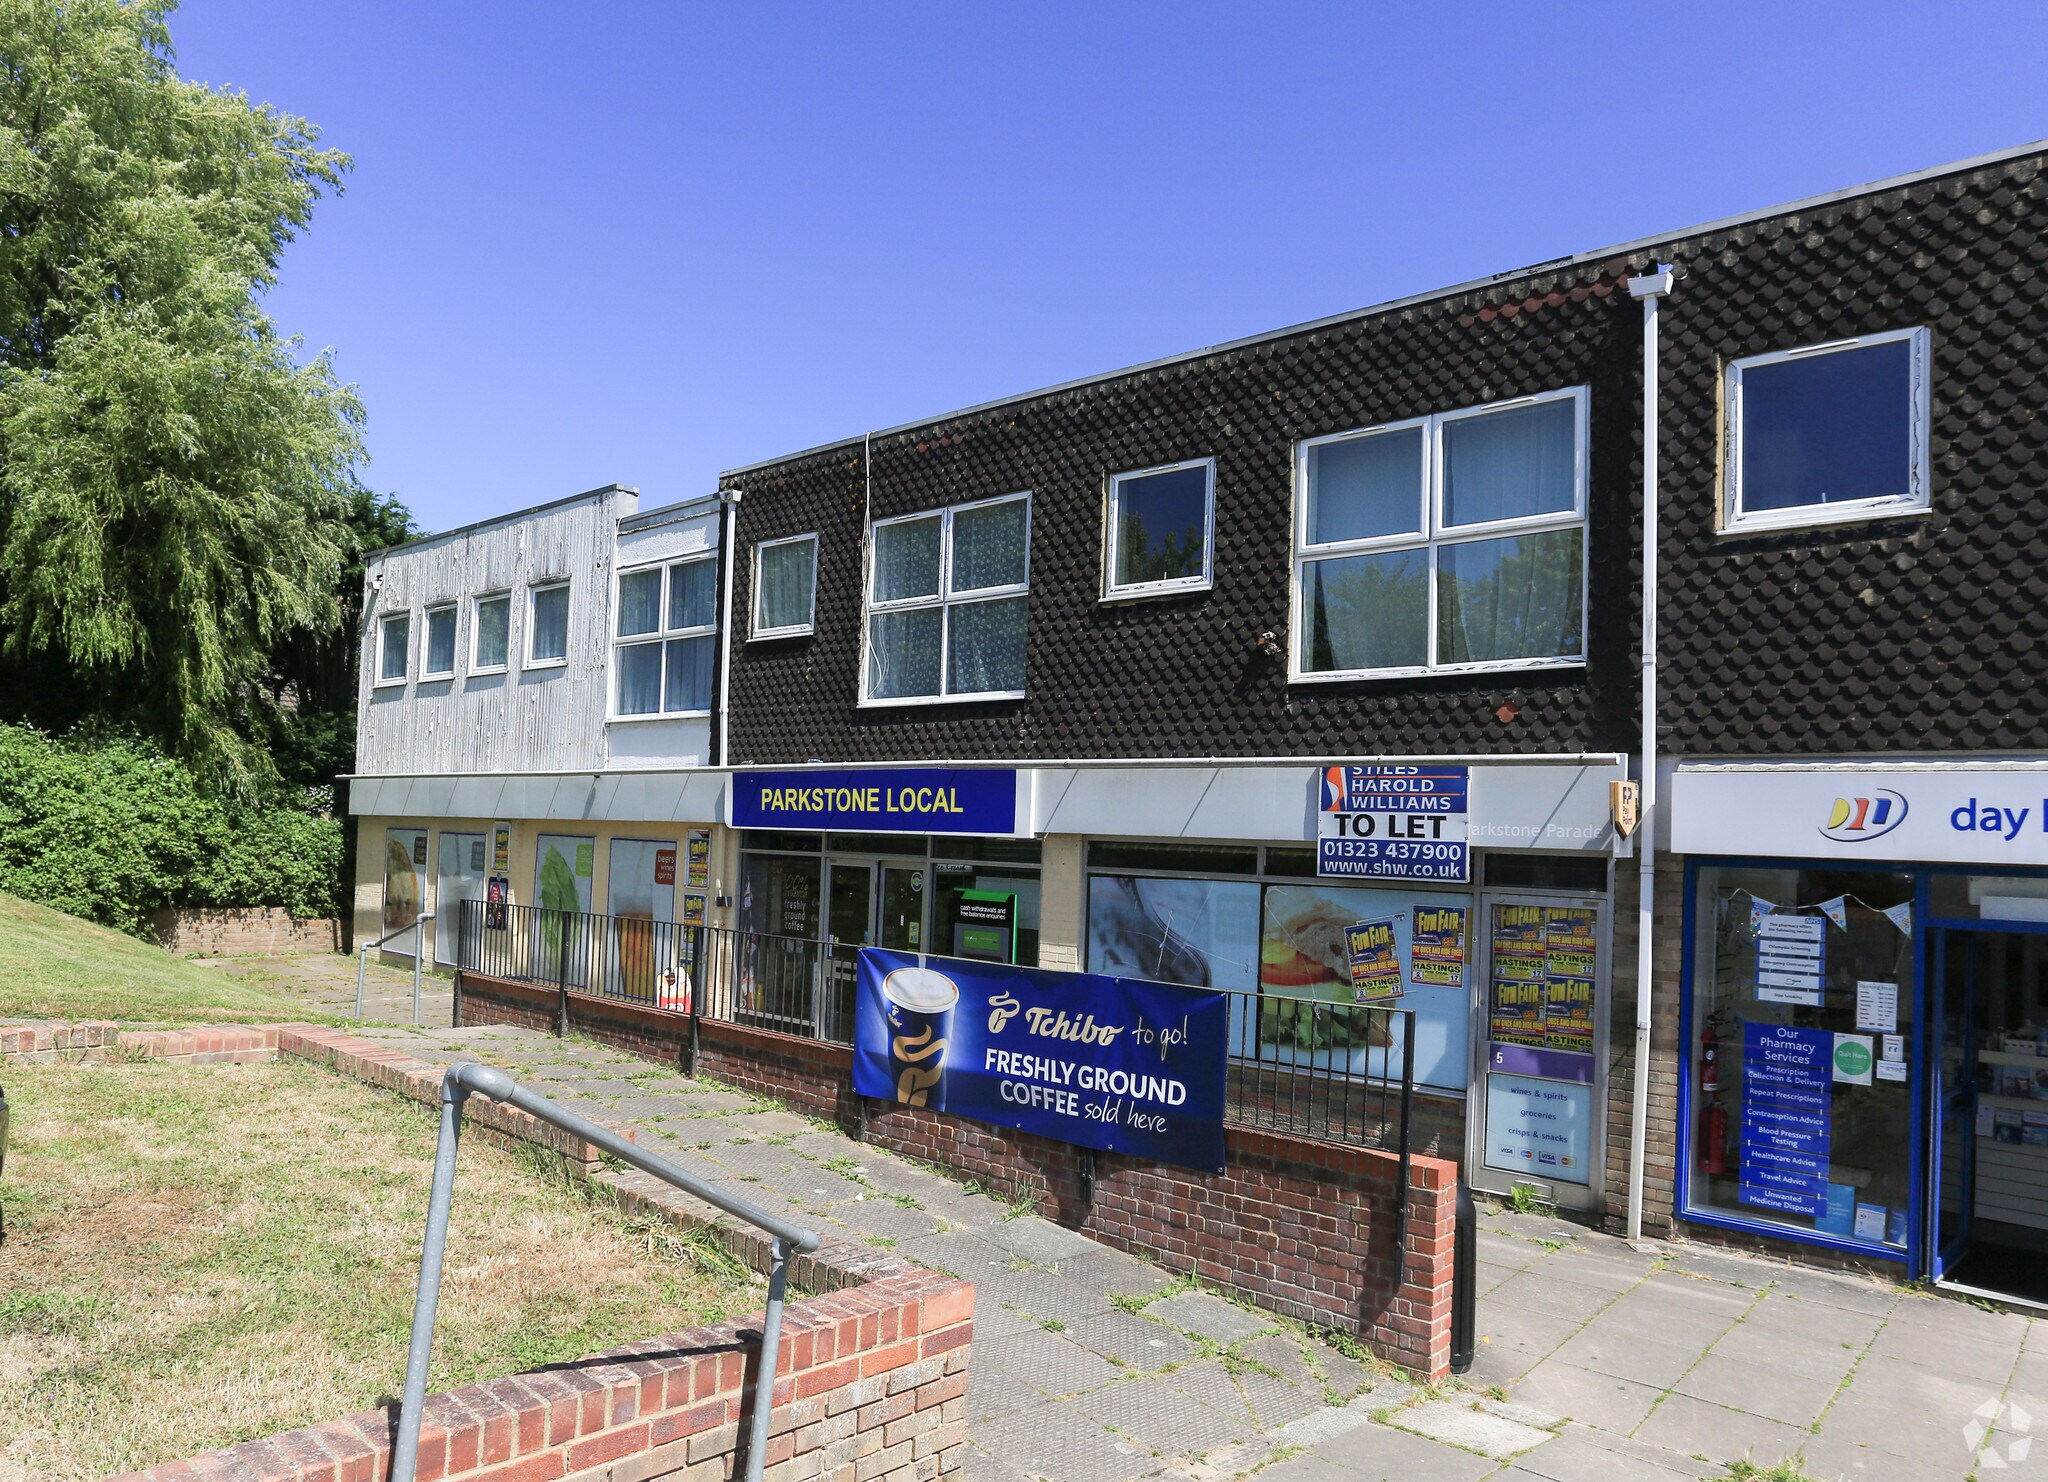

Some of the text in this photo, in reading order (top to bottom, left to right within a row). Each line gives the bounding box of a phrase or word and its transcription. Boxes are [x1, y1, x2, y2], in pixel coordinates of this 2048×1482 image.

[1352, 779, 1434, 792] HAROLD
[761, 788, 964, 813] PARKSTONE LOCAL
[1352, 796, 1450, 810] WILLIAMS
[1334, 814, 1446, 838] TO LET
[1950, 798, 2030, 841] day
[1472, 822, 1602, 838] arkstone Parade
[1324, 841, 1462, 860] 01323 437900
[658, 853, 674, 863] beers
[658, 872, 672, 880] spirits
[1324, 860, 1460, 878] www.shw.co.uk
[784, 899, 806, 912] freshly
[784, 911, 806, 921] ground
[1418, 910, 1459, 934] FUN FAIR
[1500, 906, 1540, 929] FUN FAIR
[784, 921, 804, 930] coffee
[1351, 931, 1369, 955] FUN
[1369, 926, 1389, 948] FAIR
[1496, 958, 1542, 968] HASTINGS
[1546, 953, 1594, 964] ASTINGS
[1413, 962, 1460, 973] HASTINGS
[1355, 976, 1400, 989] HASTINGS
[1498, 982, 1538, 1006] FUN FAIR
[1546, 980, 1590, 1002] FUN FAIR
[1025, 1006, 1188, 1061] Tchibo to go!
[1777, 1028, 1799, 1038] Our
[1546, 1035, 1592, 1047] ASTINGS
[1760, 1037, 1816, 1054] Pharmacy
[1496, 1052, 1503, 1063] 5
[1765, 1050, 1810, 1064] Services
[985, 1048, 1186, 1106] FRESHLY GROUND
[1766, 1066, 1809, 1076] Prescription
[1748, 1071, 1784, 1082] Collection
[1795, 1078, 1825, 1088] Delivery
[1511, 1087, 1532, 1096] wines
[1544, 1092, 1568, 1101] spirits
[1750, 1088, 1822, 1104] Repeat Prescriptions
[1000, 1080, 1167, 1132] COFFEE sold here
[1520, 1110, 1556, 1120] groceries
[1747, 1108, 1824, 1126] Contraception Advice
[1508, 1128, 1530, 1138] crisps
[1542, 1132, 1568, 1142] snacks
[1758, 1127, 1812, 1140] Blood Pressure
[1772, 1136, 1798, 1148] Testing
[1752, 1151, 1816, 1167] Healthcare Advice
[1760, 1172, 1807, 1186] Travel Advice
[1764, 1191, 1802, 1202] Unwanted
[1750, 1196, 1814, 1214] Medicine Disposal
